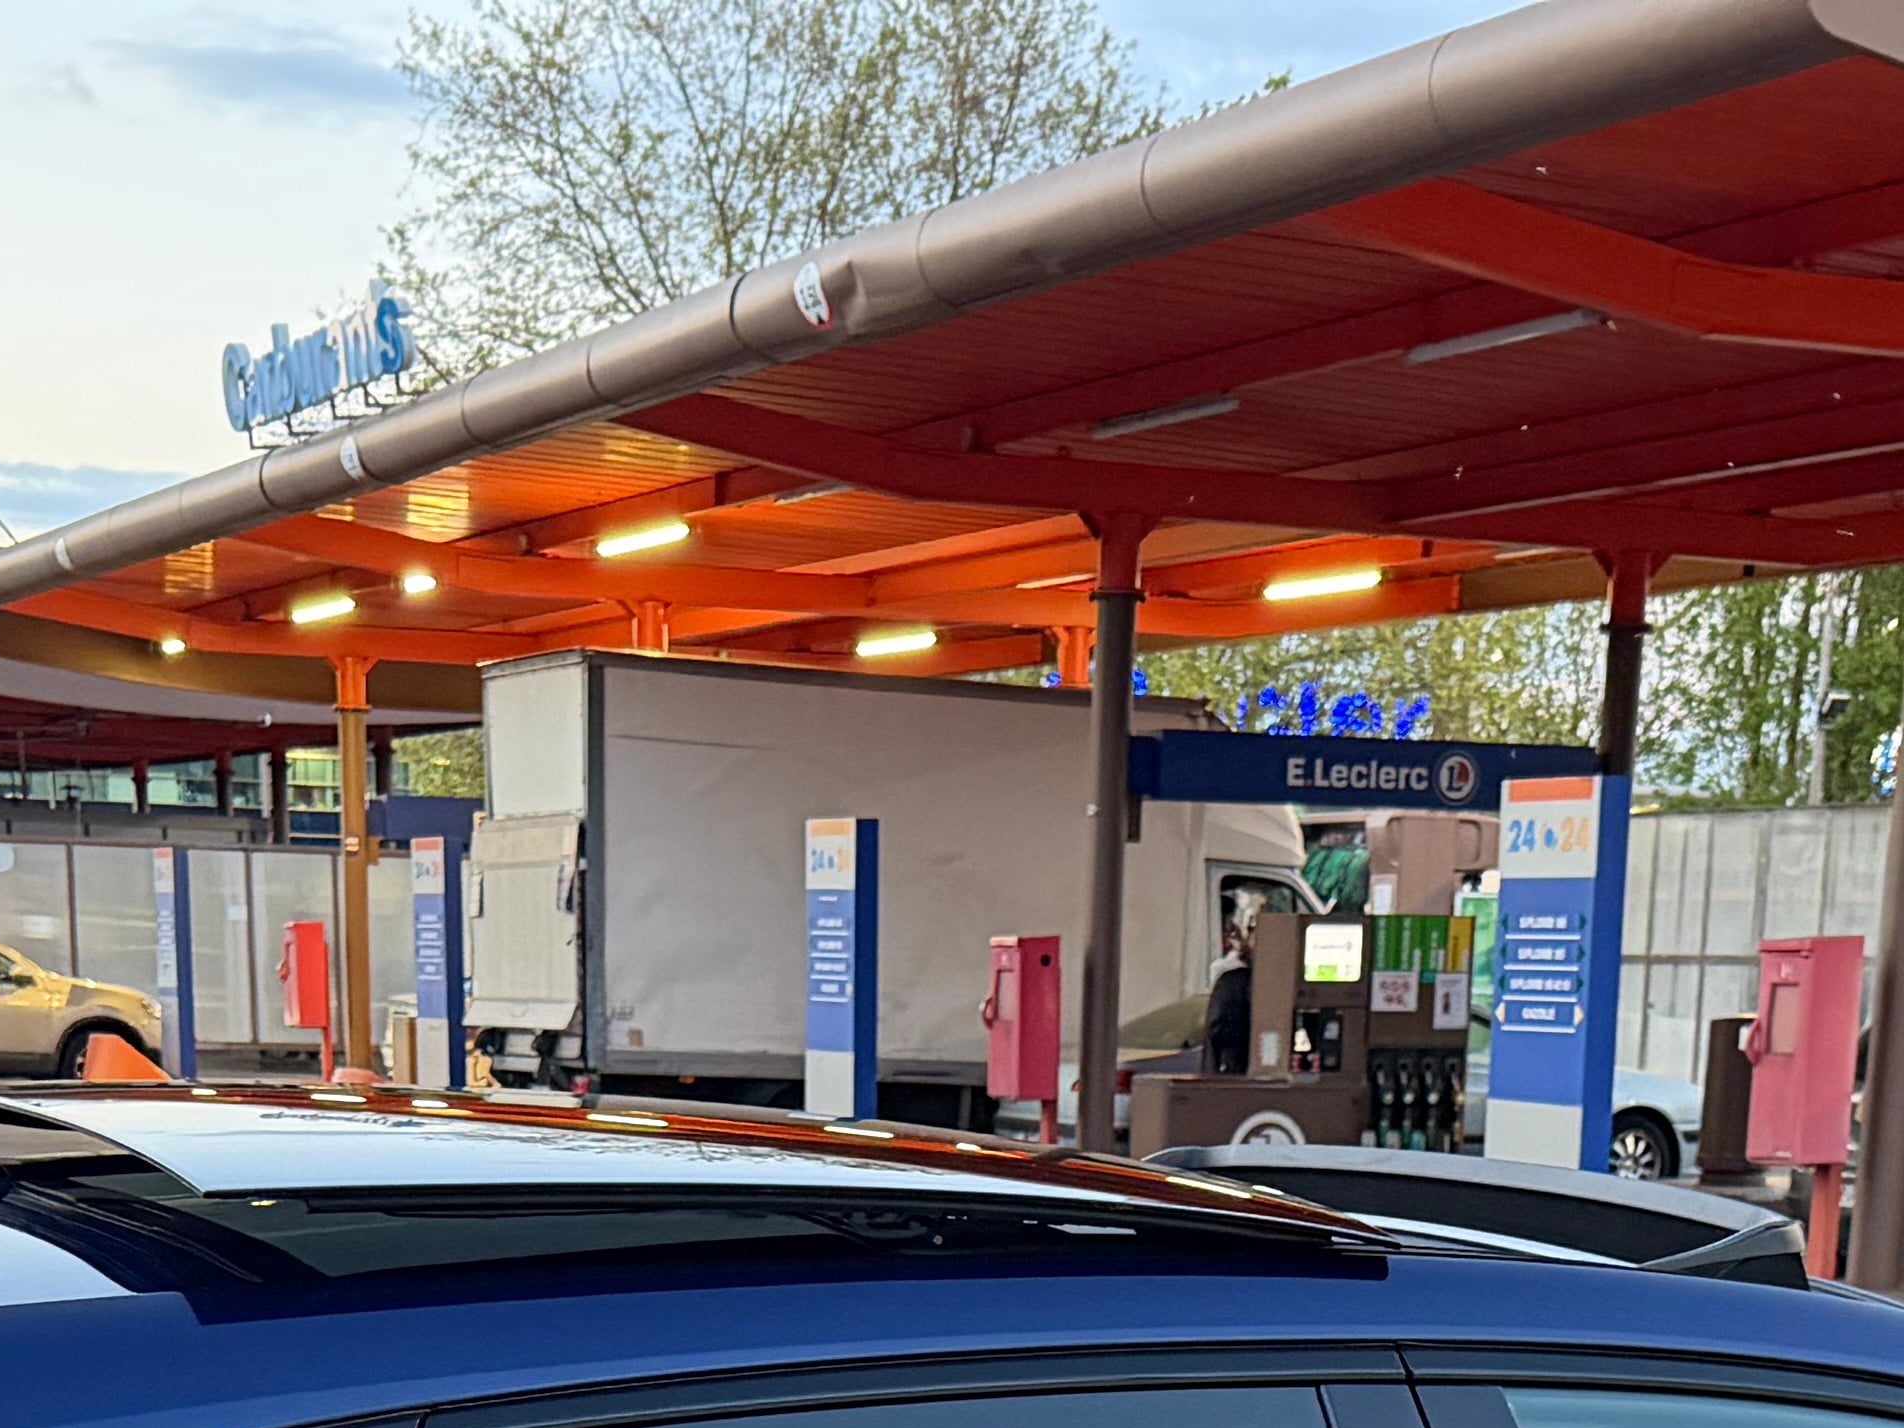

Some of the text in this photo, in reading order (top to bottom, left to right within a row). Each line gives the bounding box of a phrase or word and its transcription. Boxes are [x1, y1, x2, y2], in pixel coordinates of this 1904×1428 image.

[1286, 757, 1430, 791] E.Leclerc
[1507, 816, 1591, 853] 24 24
